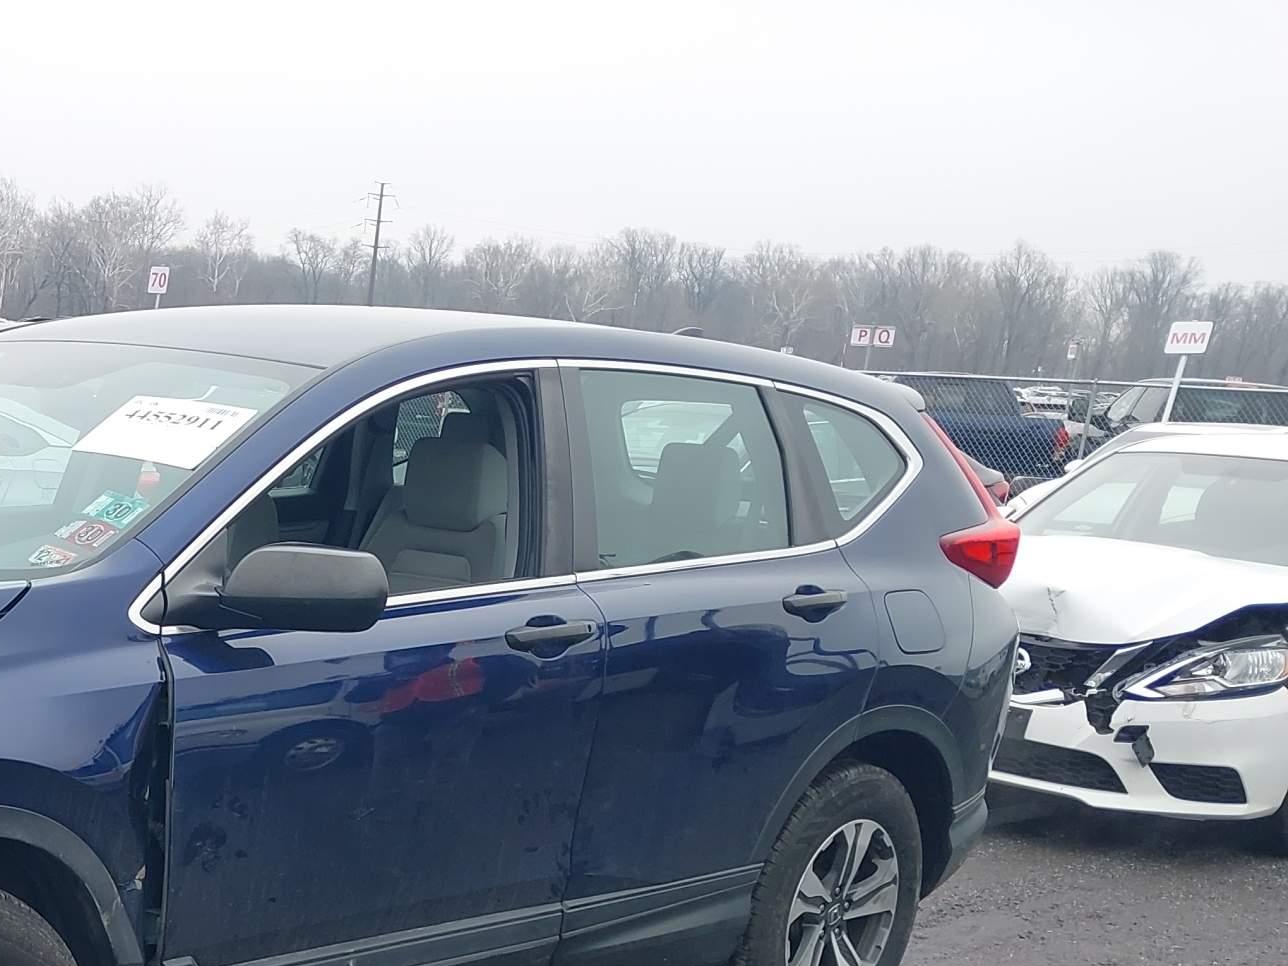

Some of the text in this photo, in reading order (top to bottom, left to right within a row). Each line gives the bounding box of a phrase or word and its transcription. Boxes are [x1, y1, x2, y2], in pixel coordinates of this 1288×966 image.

[151, 272, 167, 288] 70
[858, 329, 868, 342] P
[878, 329, 890, 344] Q
[1170, 332, 1206, 345] MM
[125, 409, 223, 430] 44552911
